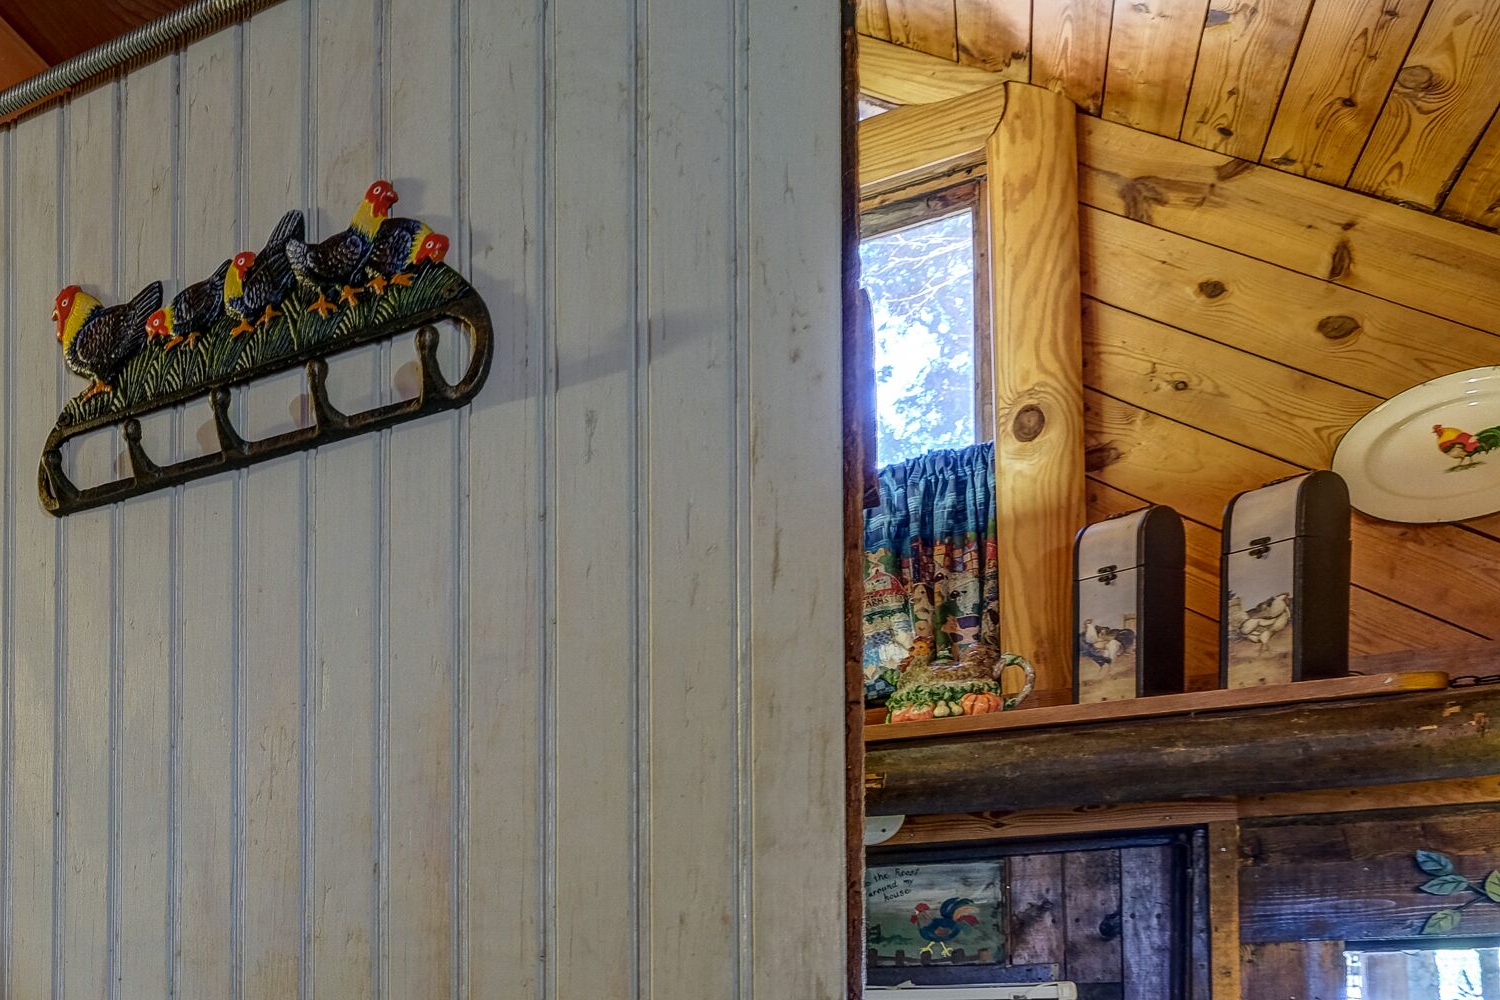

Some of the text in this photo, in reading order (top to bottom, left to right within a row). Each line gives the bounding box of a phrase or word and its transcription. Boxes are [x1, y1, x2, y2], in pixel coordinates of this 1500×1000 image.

[874, 872, 889, 882] the
[868, 880, 898, 897] around
[884, 888, 911, 902] house
